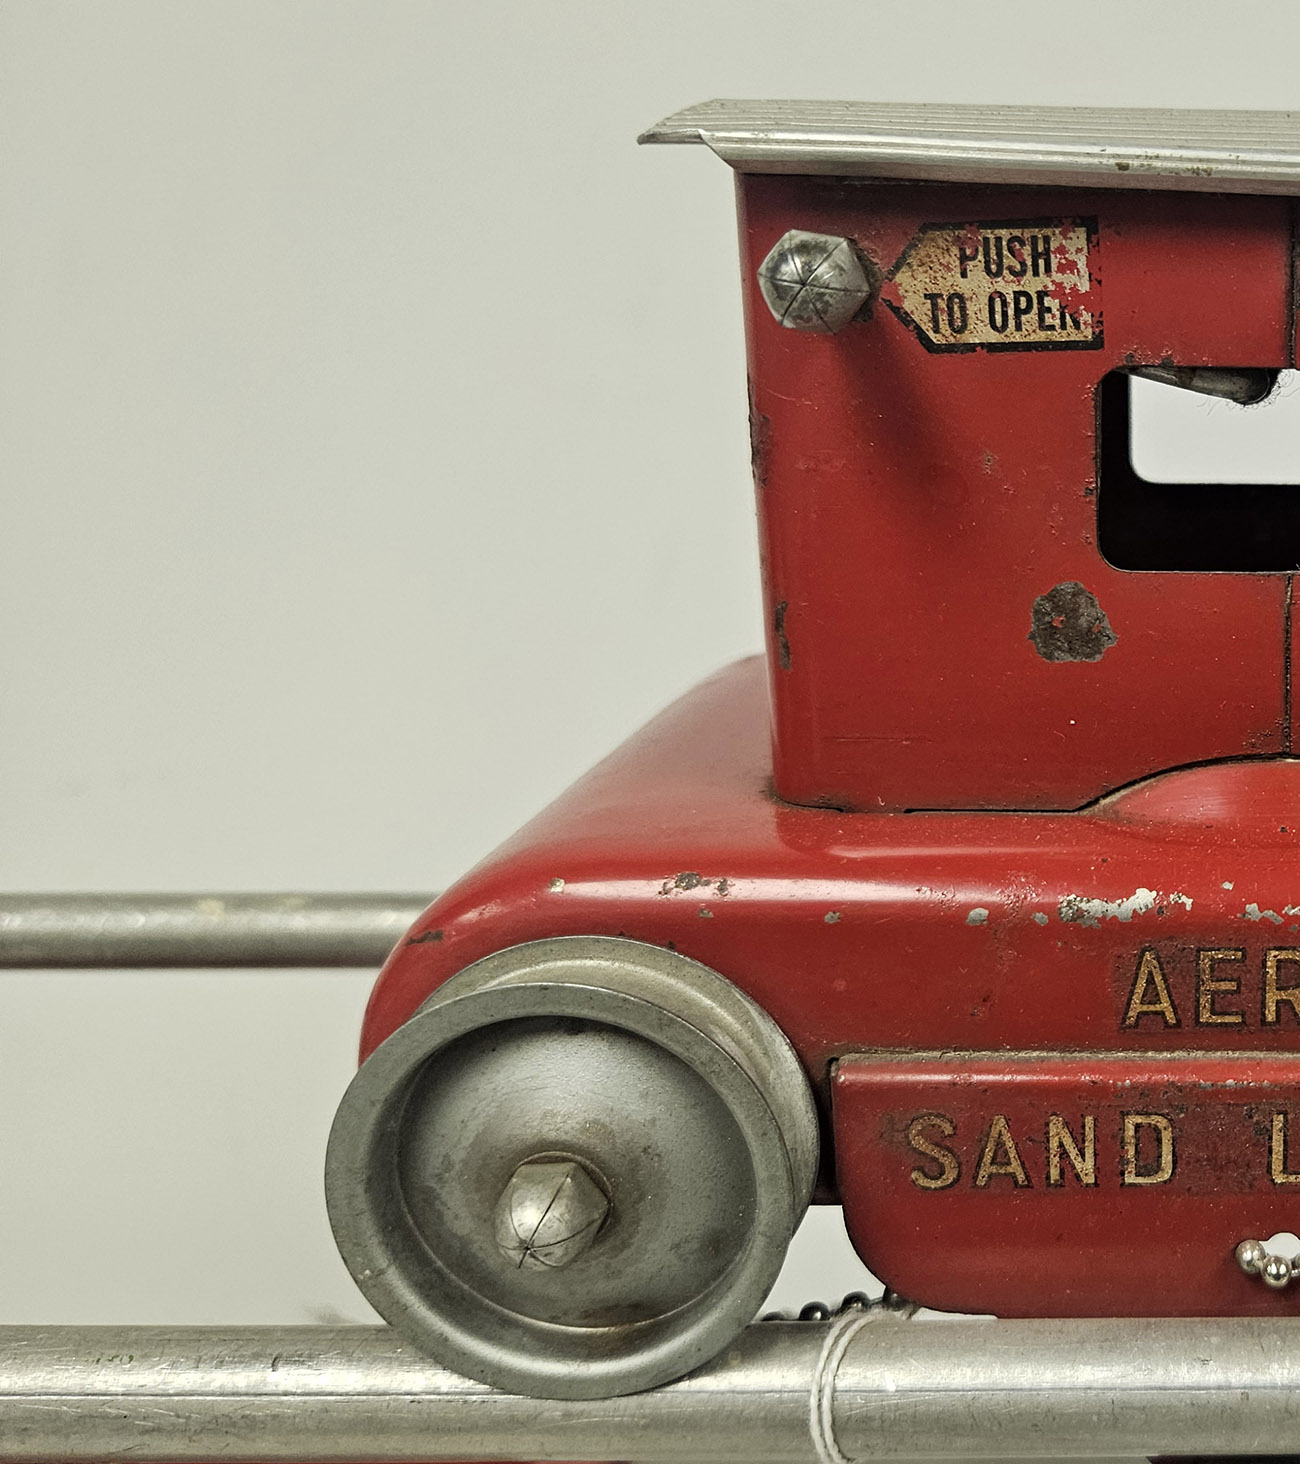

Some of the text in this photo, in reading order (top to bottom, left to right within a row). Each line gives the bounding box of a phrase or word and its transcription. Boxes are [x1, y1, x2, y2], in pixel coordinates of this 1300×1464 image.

[959, 235, 1051, 278] PUSH
[924, 290, 1081, 334] TO OPEN
[908, 1112, 1176, 1189] SAND
